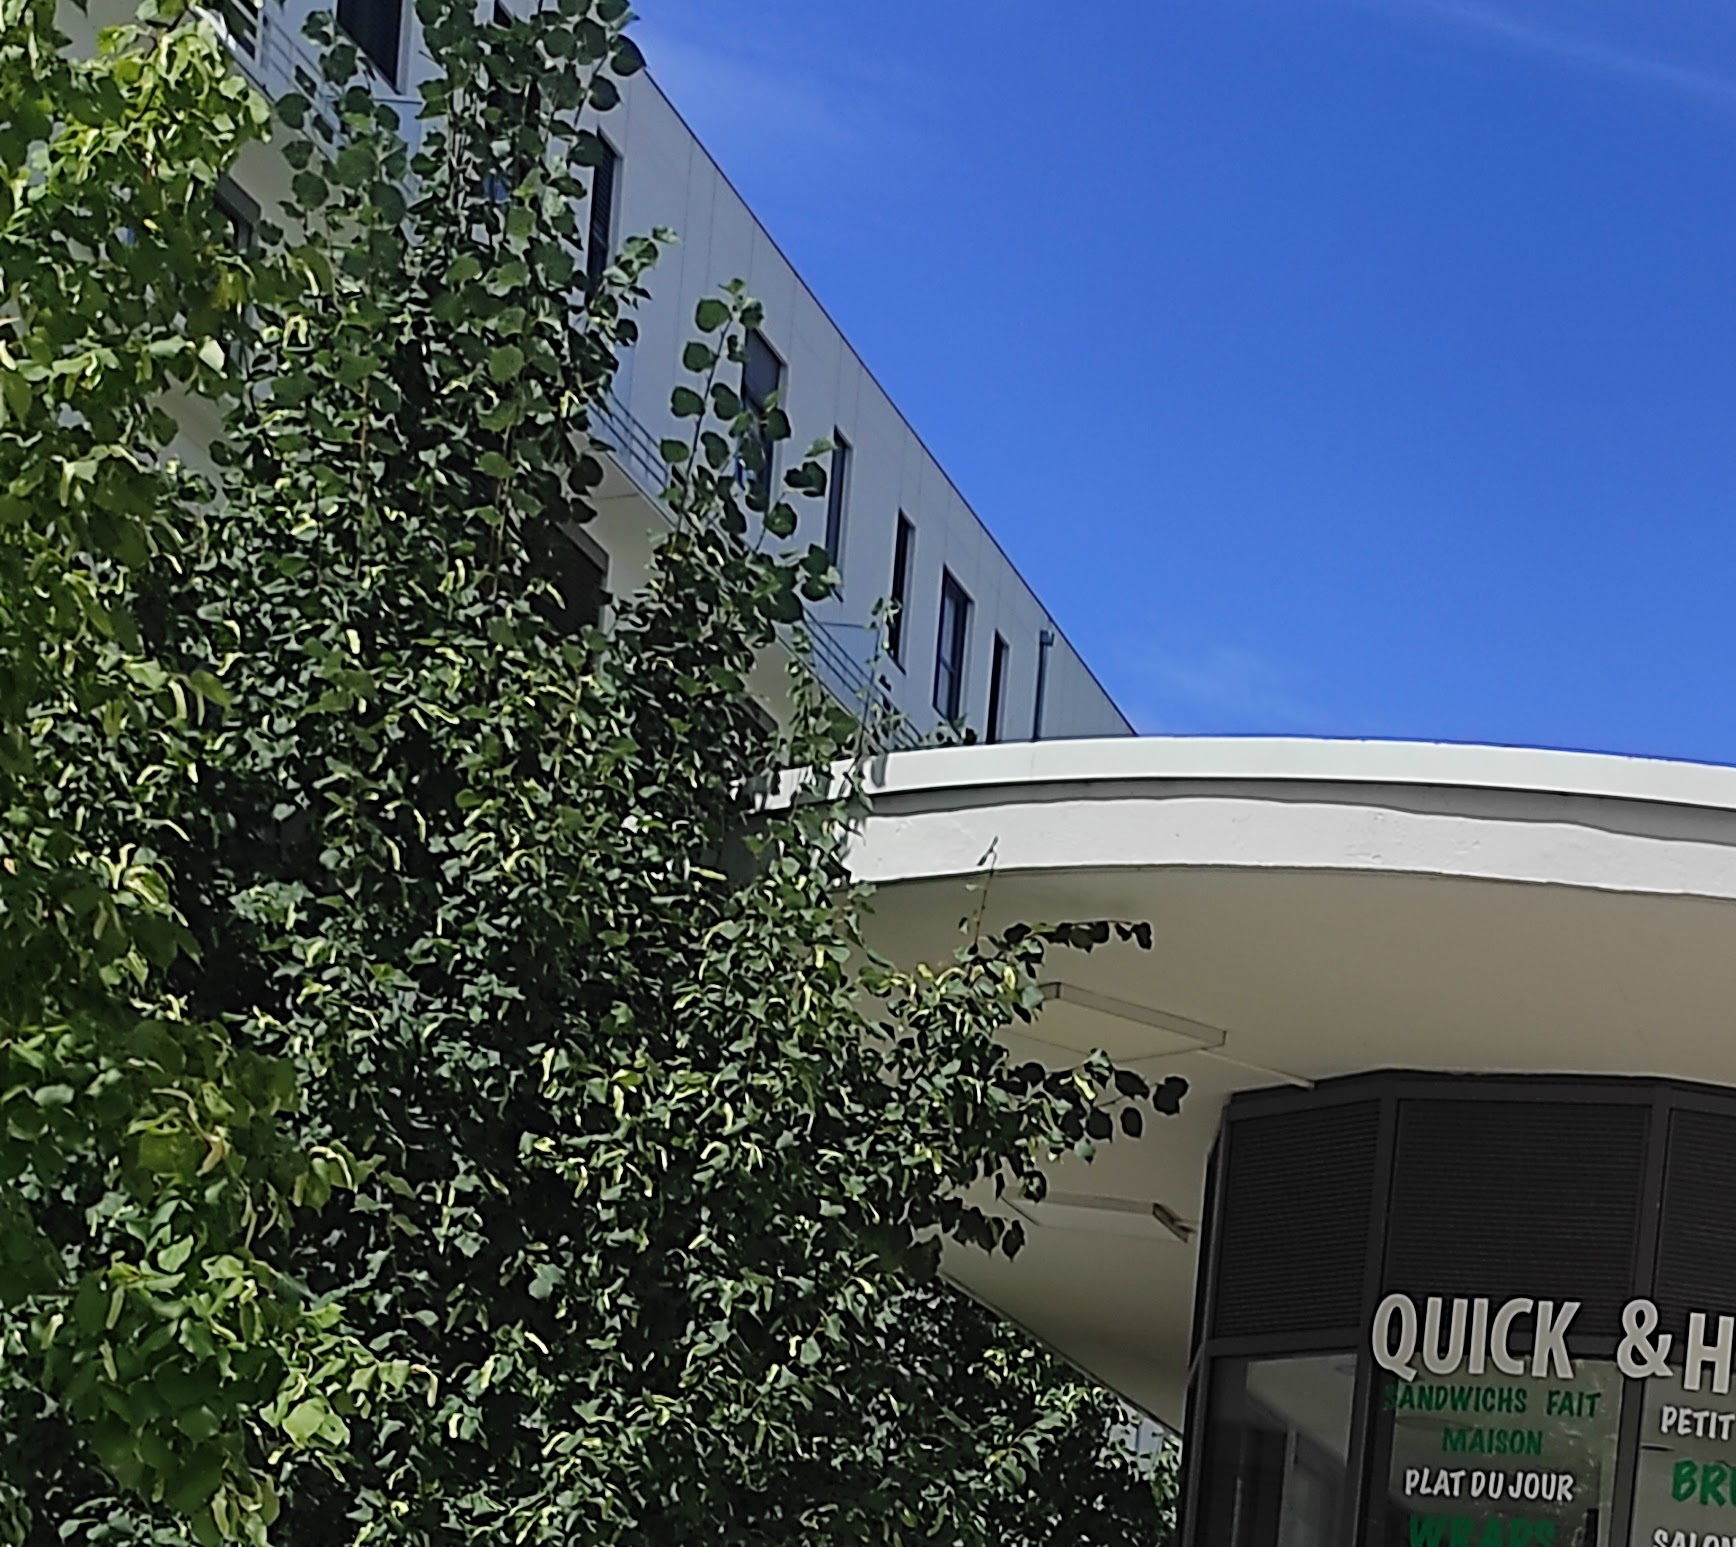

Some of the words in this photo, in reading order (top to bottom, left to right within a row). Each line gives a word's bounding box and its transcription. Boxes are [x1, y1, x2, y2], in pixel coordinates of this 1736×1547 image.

[1372, 1293, 1582, 1382] QUICK
[1384, 1384, 1527, 1413] SANDWICHS
[1546, 1389, 1602, 1417] FAIT
[1661, 1405, 1736, 1441] PETIT
[1442, 1427, 1543, 1456] MAISON
[1405, 1467, 1466, 1497] PLAT
[1470, 1471, 1504, 1499] DU
[1508, 1472, 1575, 1501] JOUR
